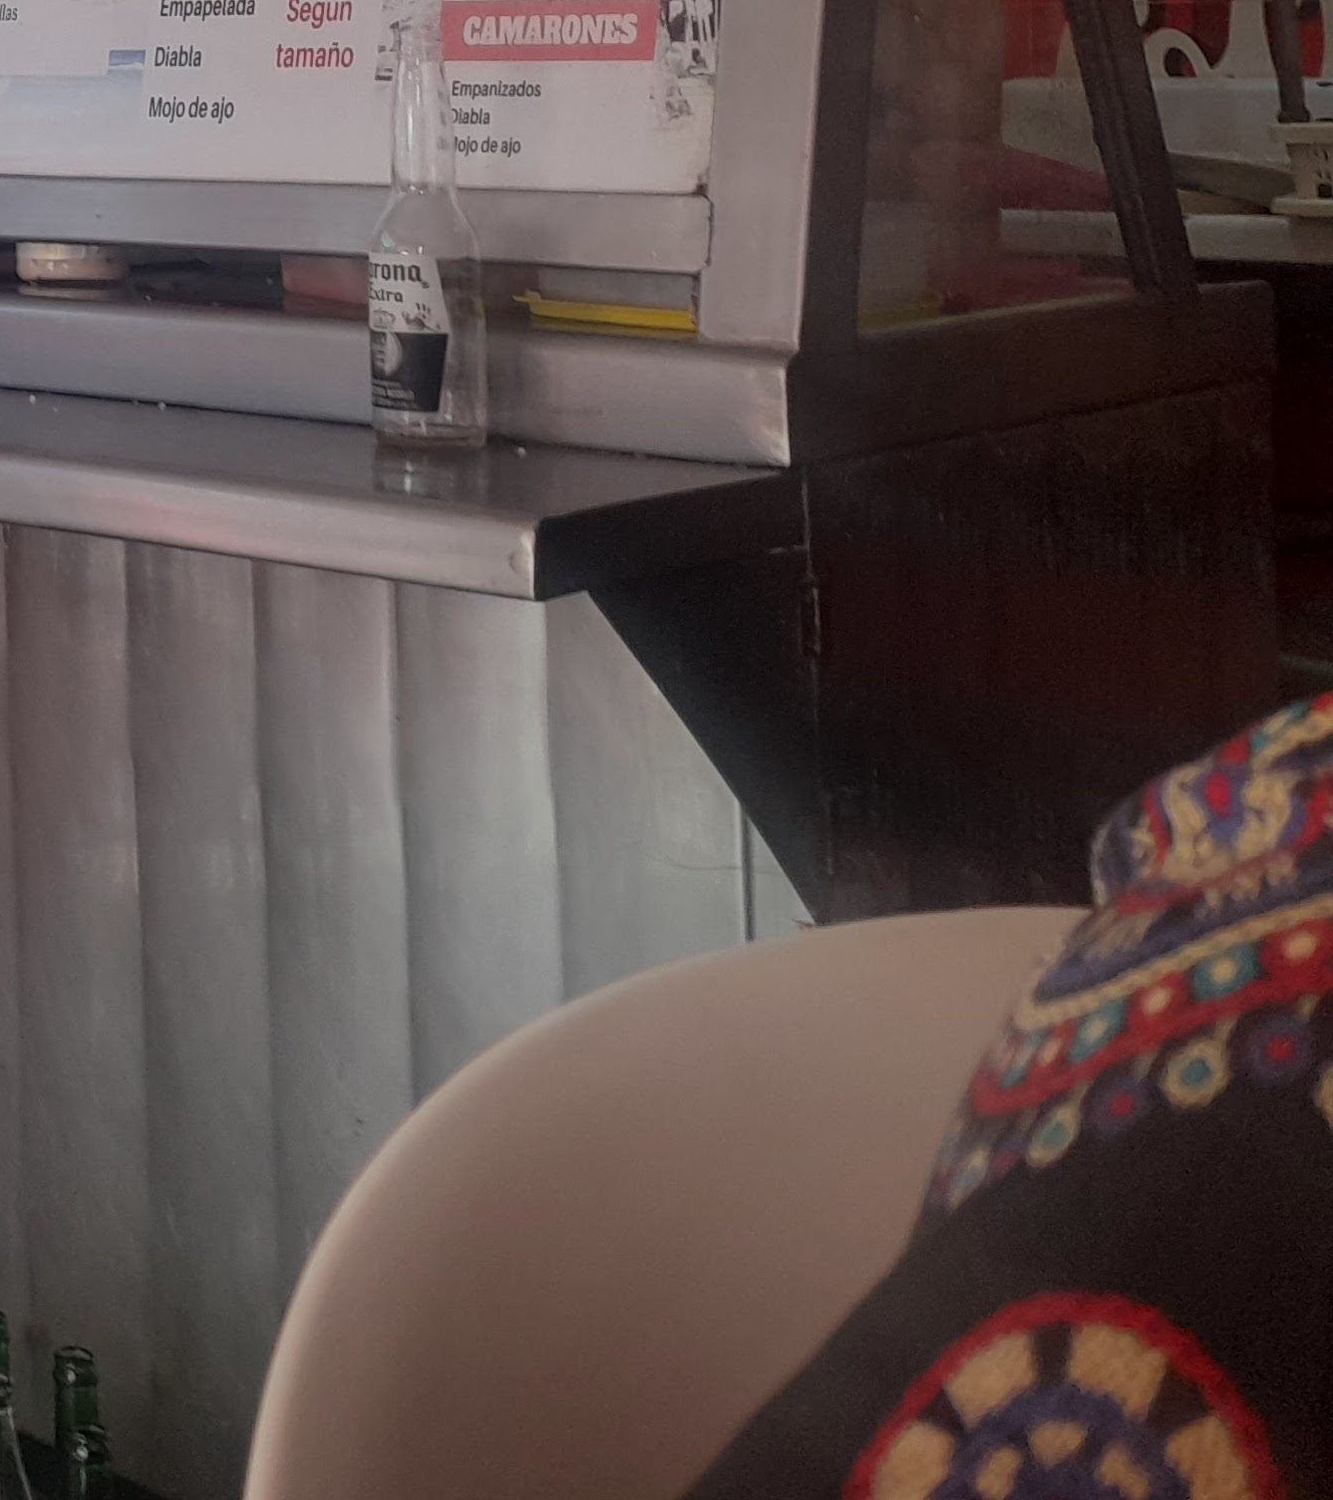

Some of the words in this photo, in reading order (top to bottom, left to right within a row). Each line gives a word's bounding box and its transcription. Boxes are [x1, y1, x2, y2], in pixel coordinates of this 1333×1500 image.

[462, 13, 639, 49] CAMARONES
[153, 45, 203, 69] Diabla
[274, 42, 355, 71] tamaño
[450, 79, 542, 100] Empanizados
[148, 94, 186, 123] Mojo
[187, 96, 207, 120] de
[209, 96, 235, 125] ajo
[480, 137, 499, 155] de
[500, 137, 523, 158] ajo
